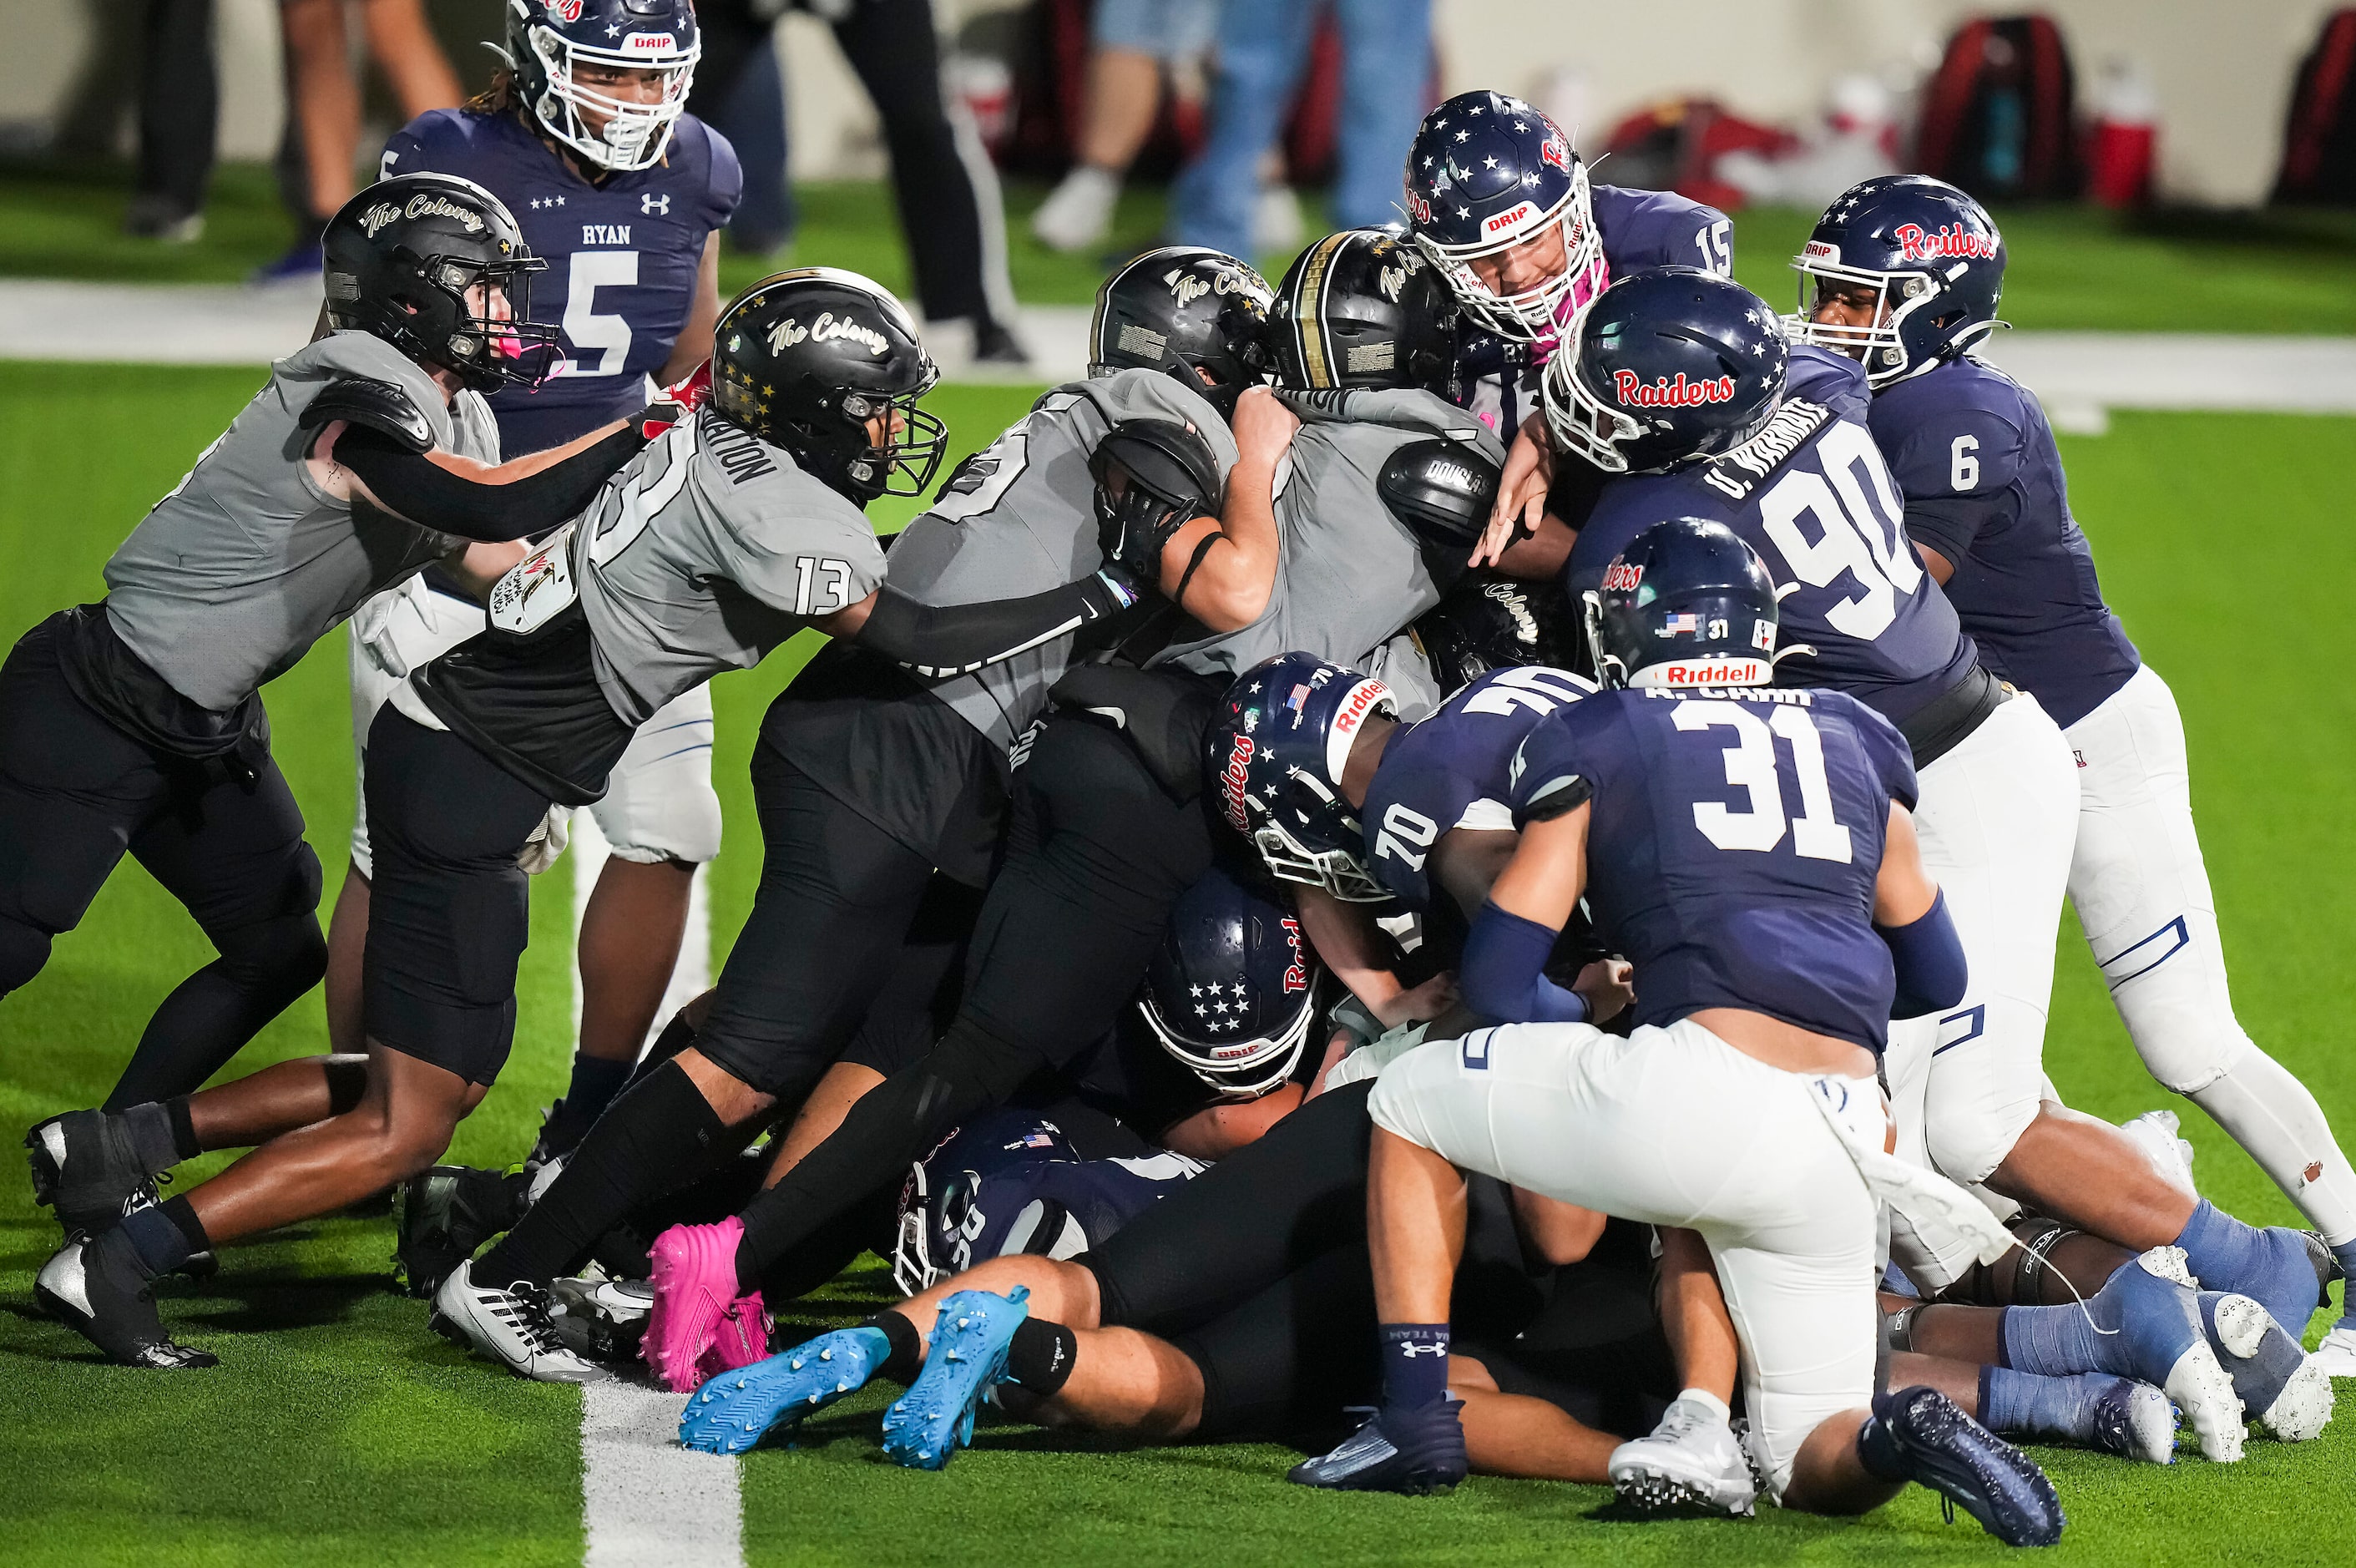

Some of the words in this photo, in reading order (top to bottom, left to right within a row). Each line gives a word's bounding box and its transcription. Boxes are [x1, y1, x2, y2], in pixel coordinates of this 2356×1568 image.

[635, 38, 670, 48] DRIP
[362, 201, 402, 239] The
[405, 194, 484, 233] Colony
[582, 225, 631, 245] RYAN
[1488, 206, 1528, 232] DRIP
[1695, 219, 1732, 277] 15
[1805, 242, 1832, 257] DRIP
[1893, 221, 1996, 262] Raiders
[1170, 274, 1211, 309] The
[1379, 265, 1407, 304] The
[562, 250, 640, 378] 5
[1530, 303, 1554, 318] Riddll
[767, 318, 809, 357] The
[811, 311, 890, 356] Colony
[1613, 368, 1737, 408] Raiders
[1424, 459, 1490, 498] DOUGLAS
[1950, 434, 1980, 492] 6
[1758, 418, 1925, 642] 90
[795, 556, 853, 616] 13
[1484, 583, 1539, 645] Colony
[1708, 619, 1729, 640] 31
[1311, 668, 1333, 685] 70
[1668, 665, 1757, 684] Riddell
[1336, 679, 1389, 735] Riddell
[1669, 699, 1853, 865] 31
[1374, 802, 1439, 872] 70
[1216, 1044, 1260, 1059] DRIP
